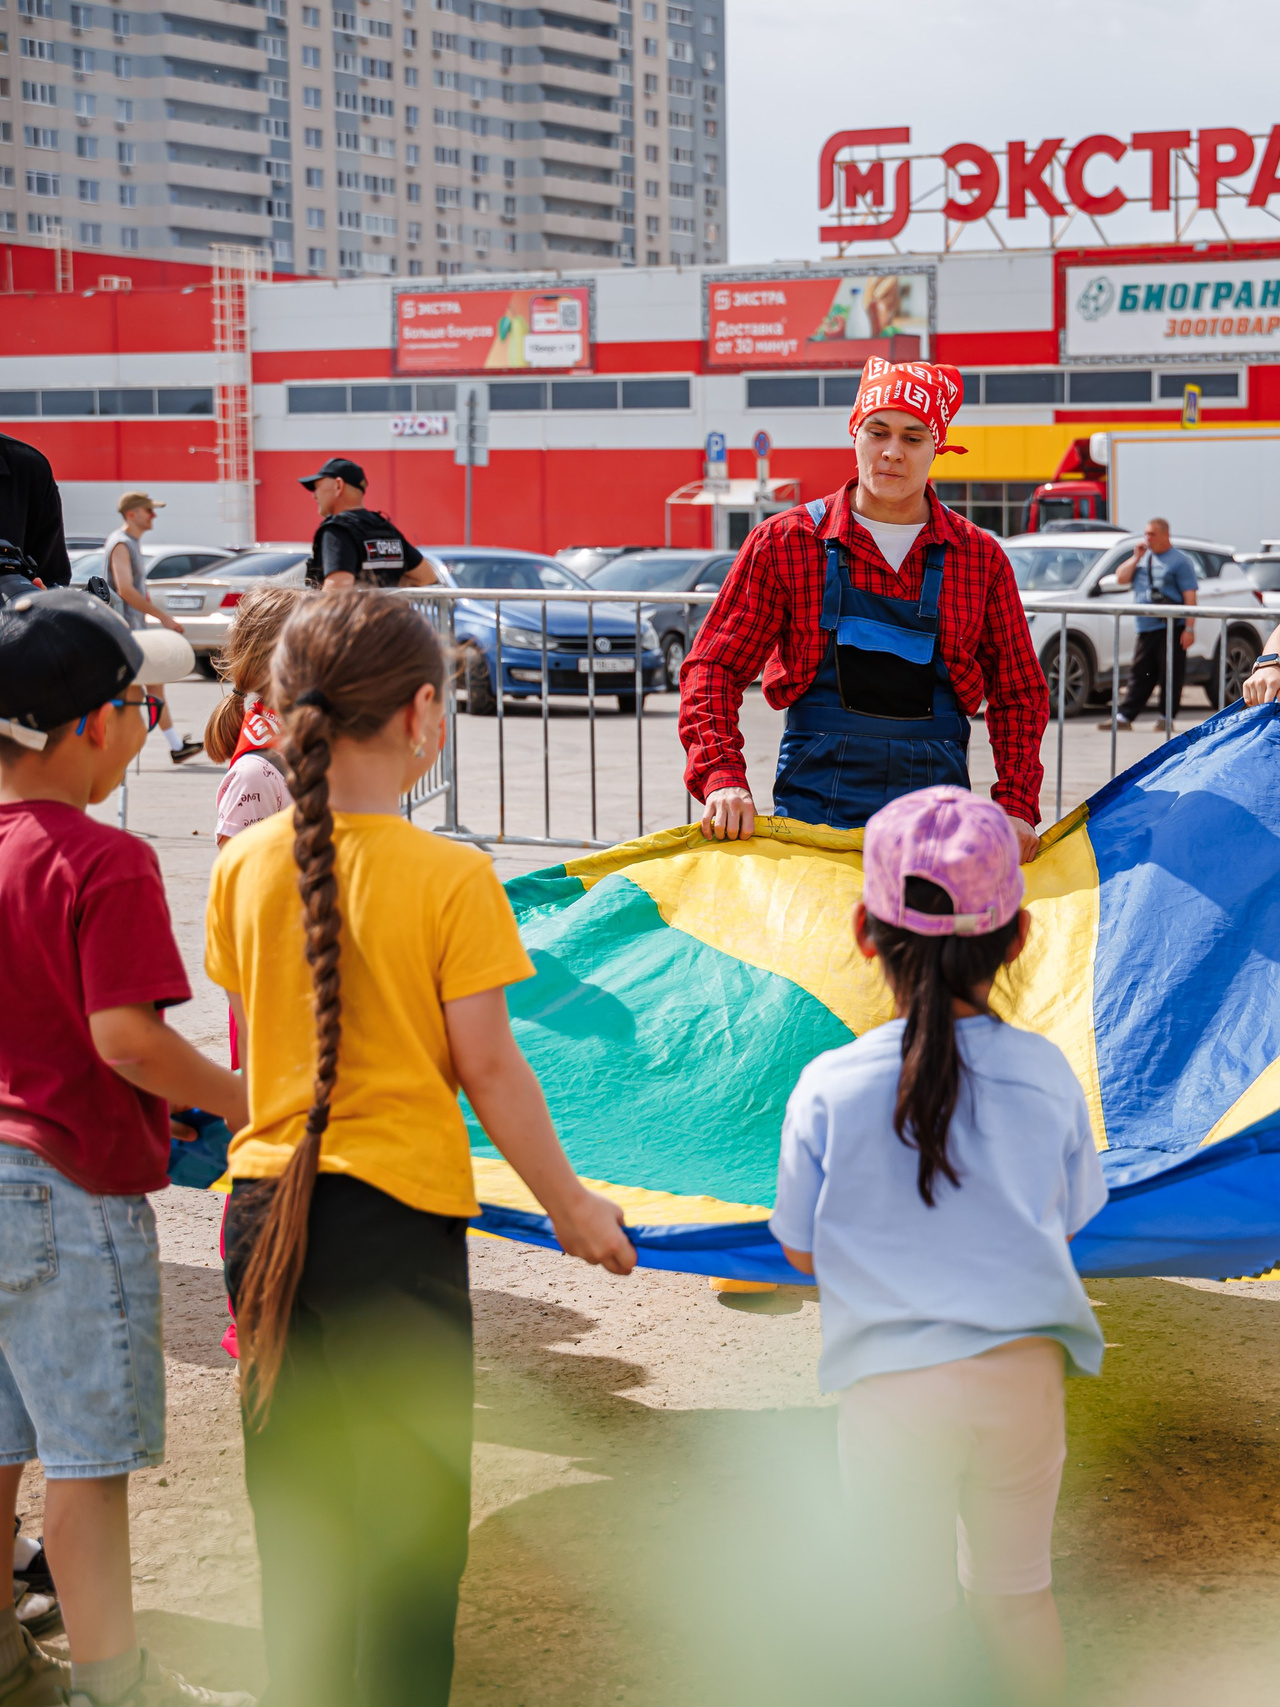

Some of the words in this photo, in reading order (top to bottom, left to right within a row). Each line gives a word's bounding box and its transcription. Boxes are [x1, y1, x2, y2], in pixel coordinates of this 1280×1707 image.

[733, 290, 787, 307] ЭКСТРА
[417, 302, 462, 315] ЭКСТРА
[447, 324, 494, 341] бонусов
[715, 341, 732, 354] от
[734, 338, 754, 354] 30
[755, 340, 798, 356] минут
[240, 792, 261, 803] Love
